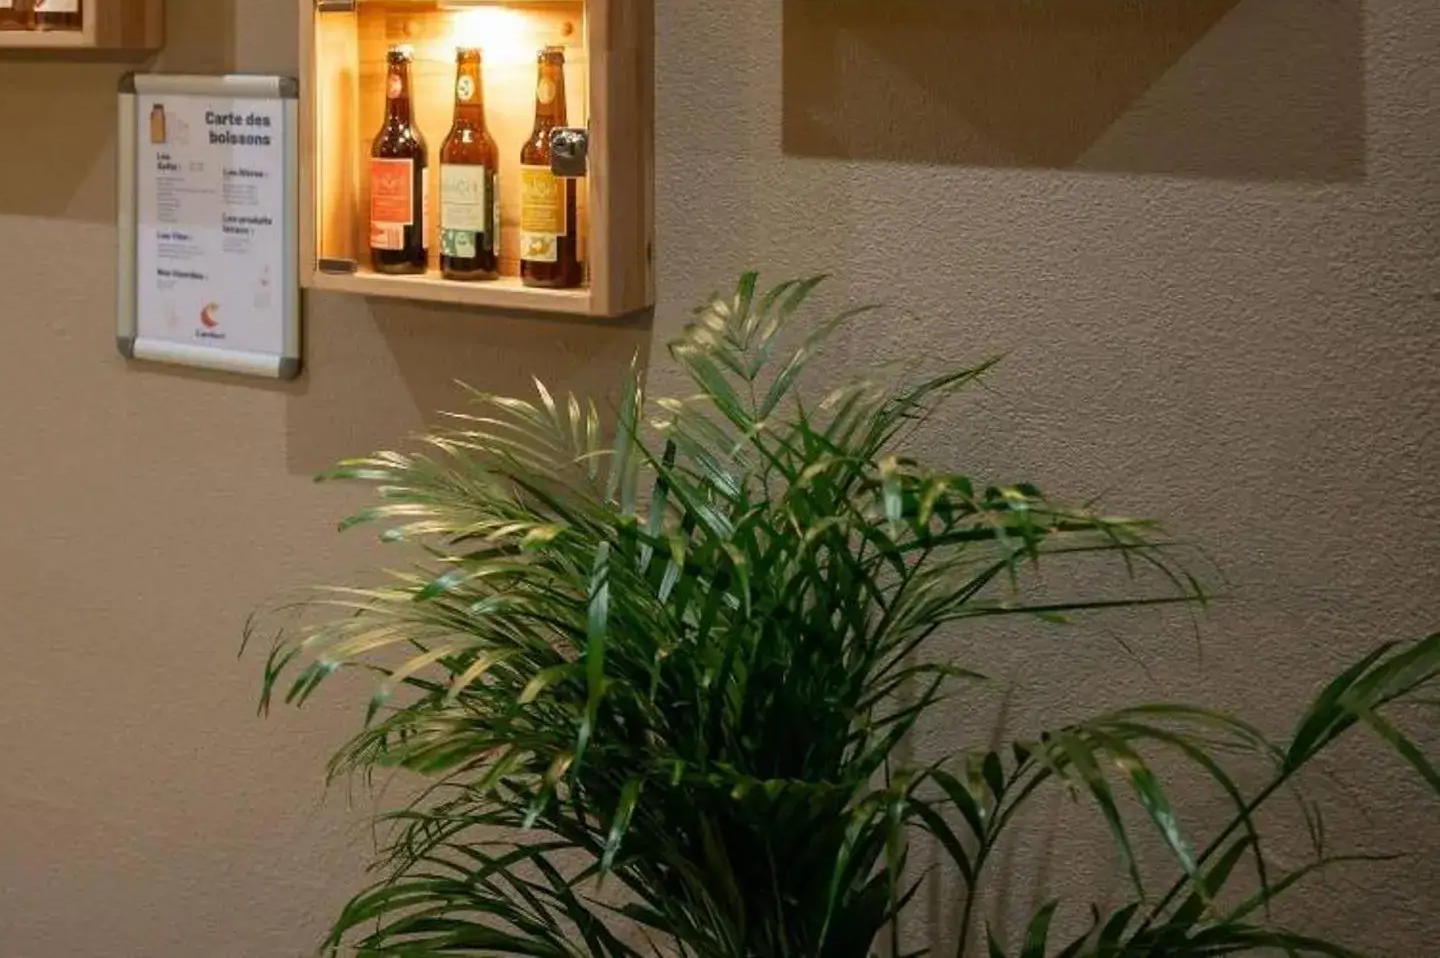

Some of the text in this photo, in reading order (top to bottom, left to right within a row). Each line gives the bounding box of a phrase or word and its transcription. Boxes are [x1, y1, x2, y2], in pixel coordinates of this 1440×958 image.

[205, 110, 271, 127] Carte des
[208, 130, 271, 146] boissons
